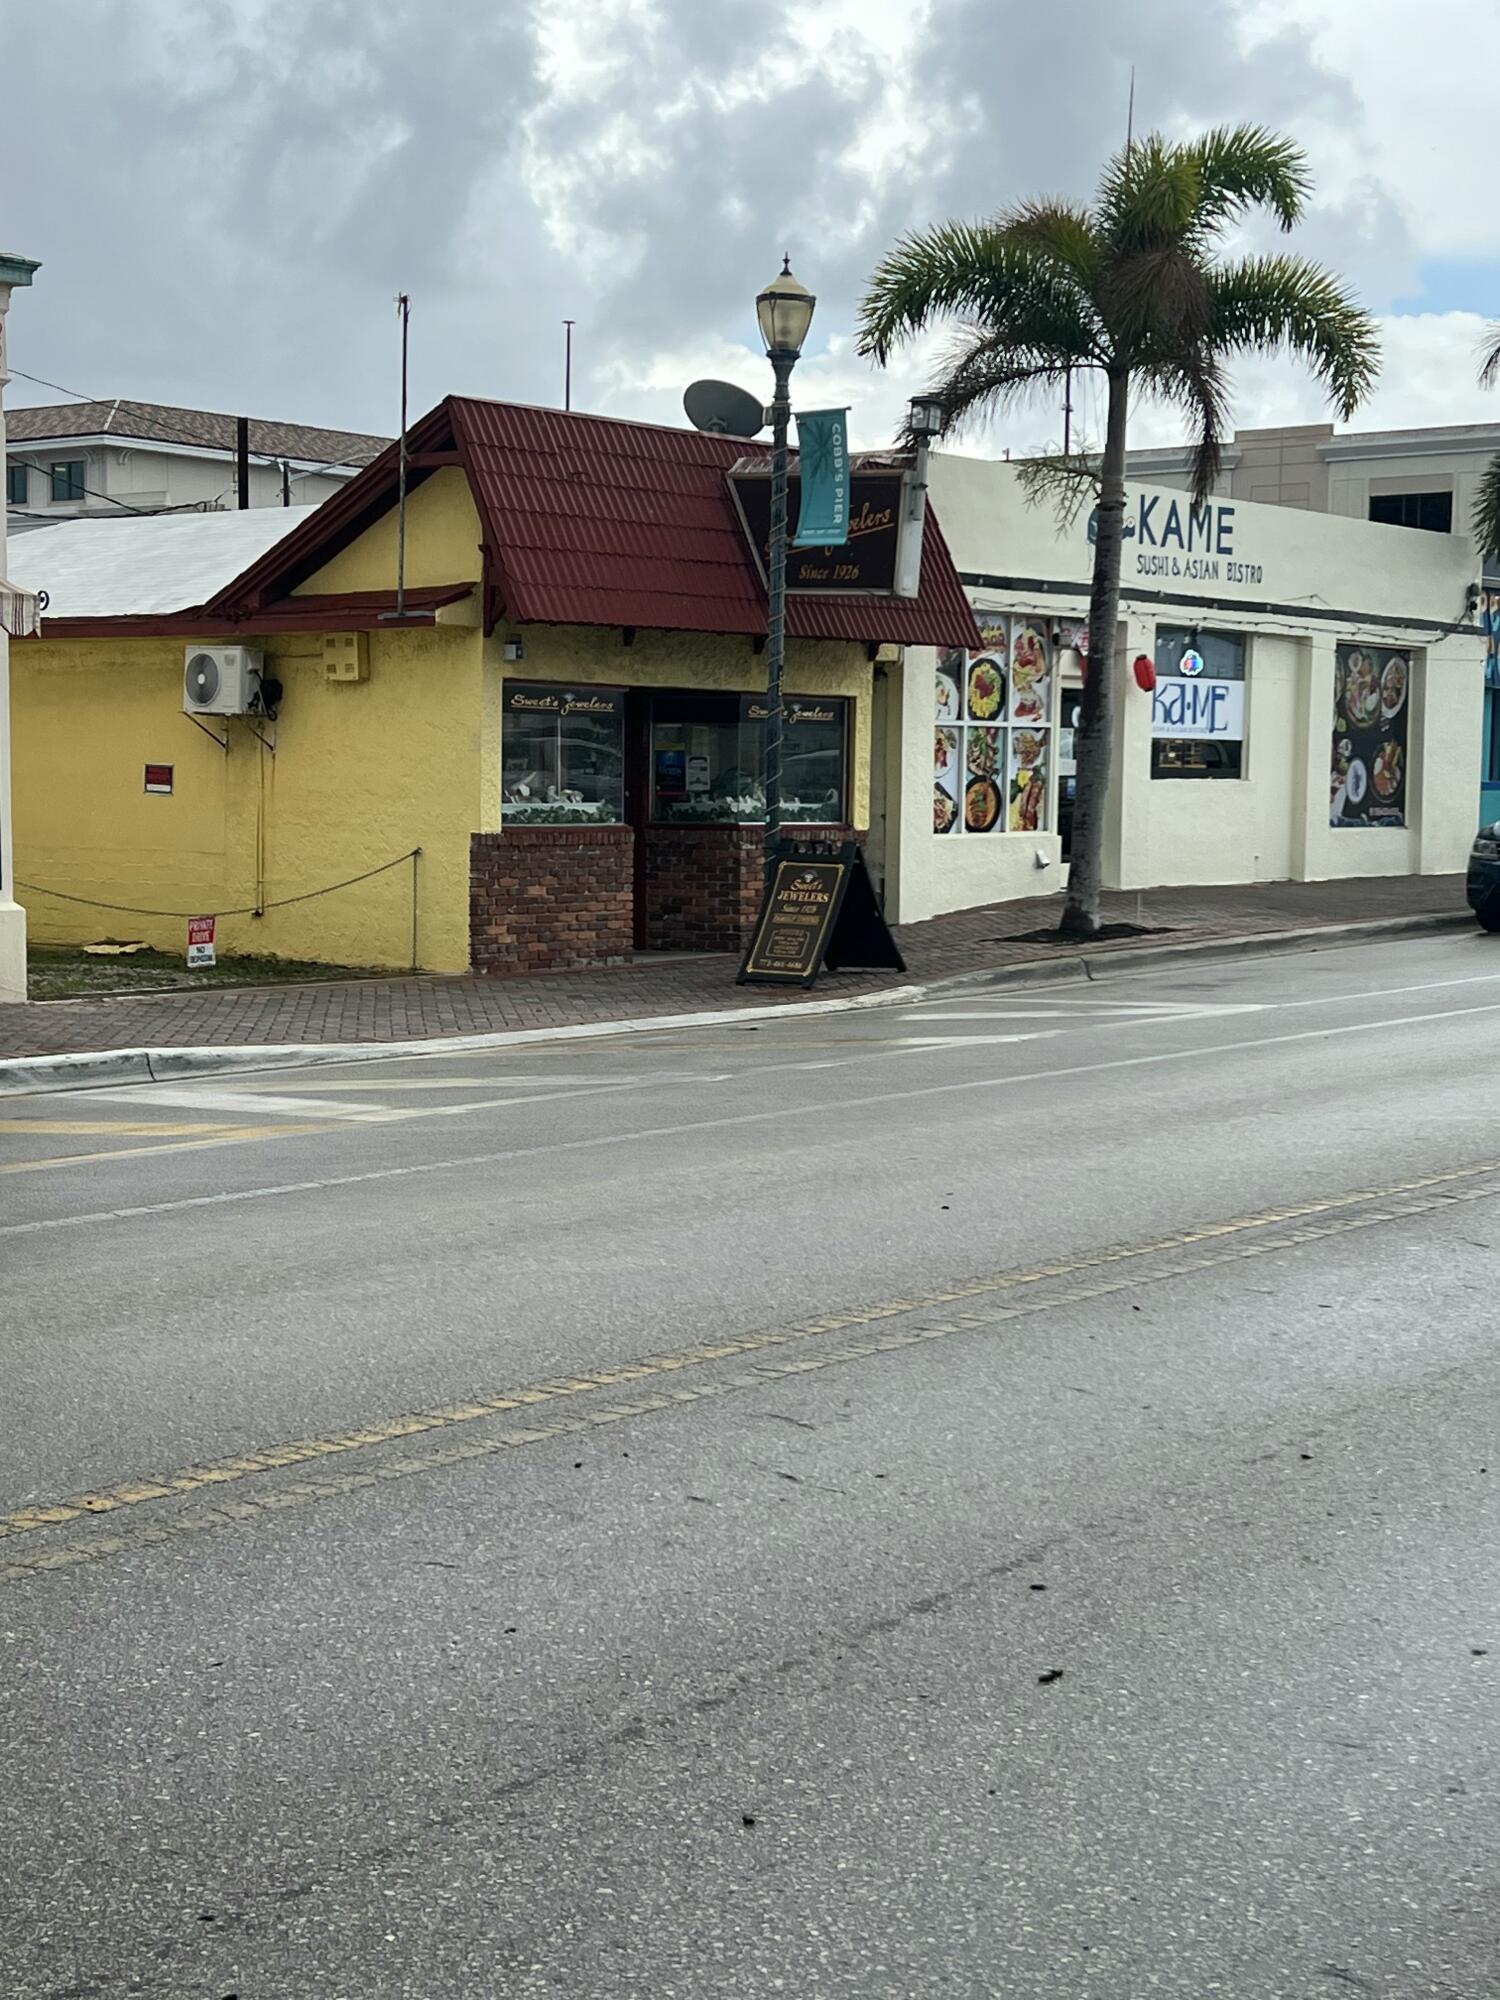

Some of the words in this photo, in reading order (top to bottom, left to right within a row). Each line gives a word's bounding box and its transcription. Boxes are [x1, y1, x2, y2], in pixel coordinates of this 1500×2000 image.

[832, 423, 844, 483] COBB'S
[833, 487, 845, 524] PIER
[1138, 494, 1235, 555] KAME
[799, 564, 828, 579] Since
[832, 565, 860, 580] 1926
[1136, 554, 1169, 577] SUSHI
[1171, 557, 1181, 576] &
[1183, 559, 1219, 580] ASIAN
[1226, 562, 1263, 584] BISTRO
[777, 890, 830, 903] JEWELERS
